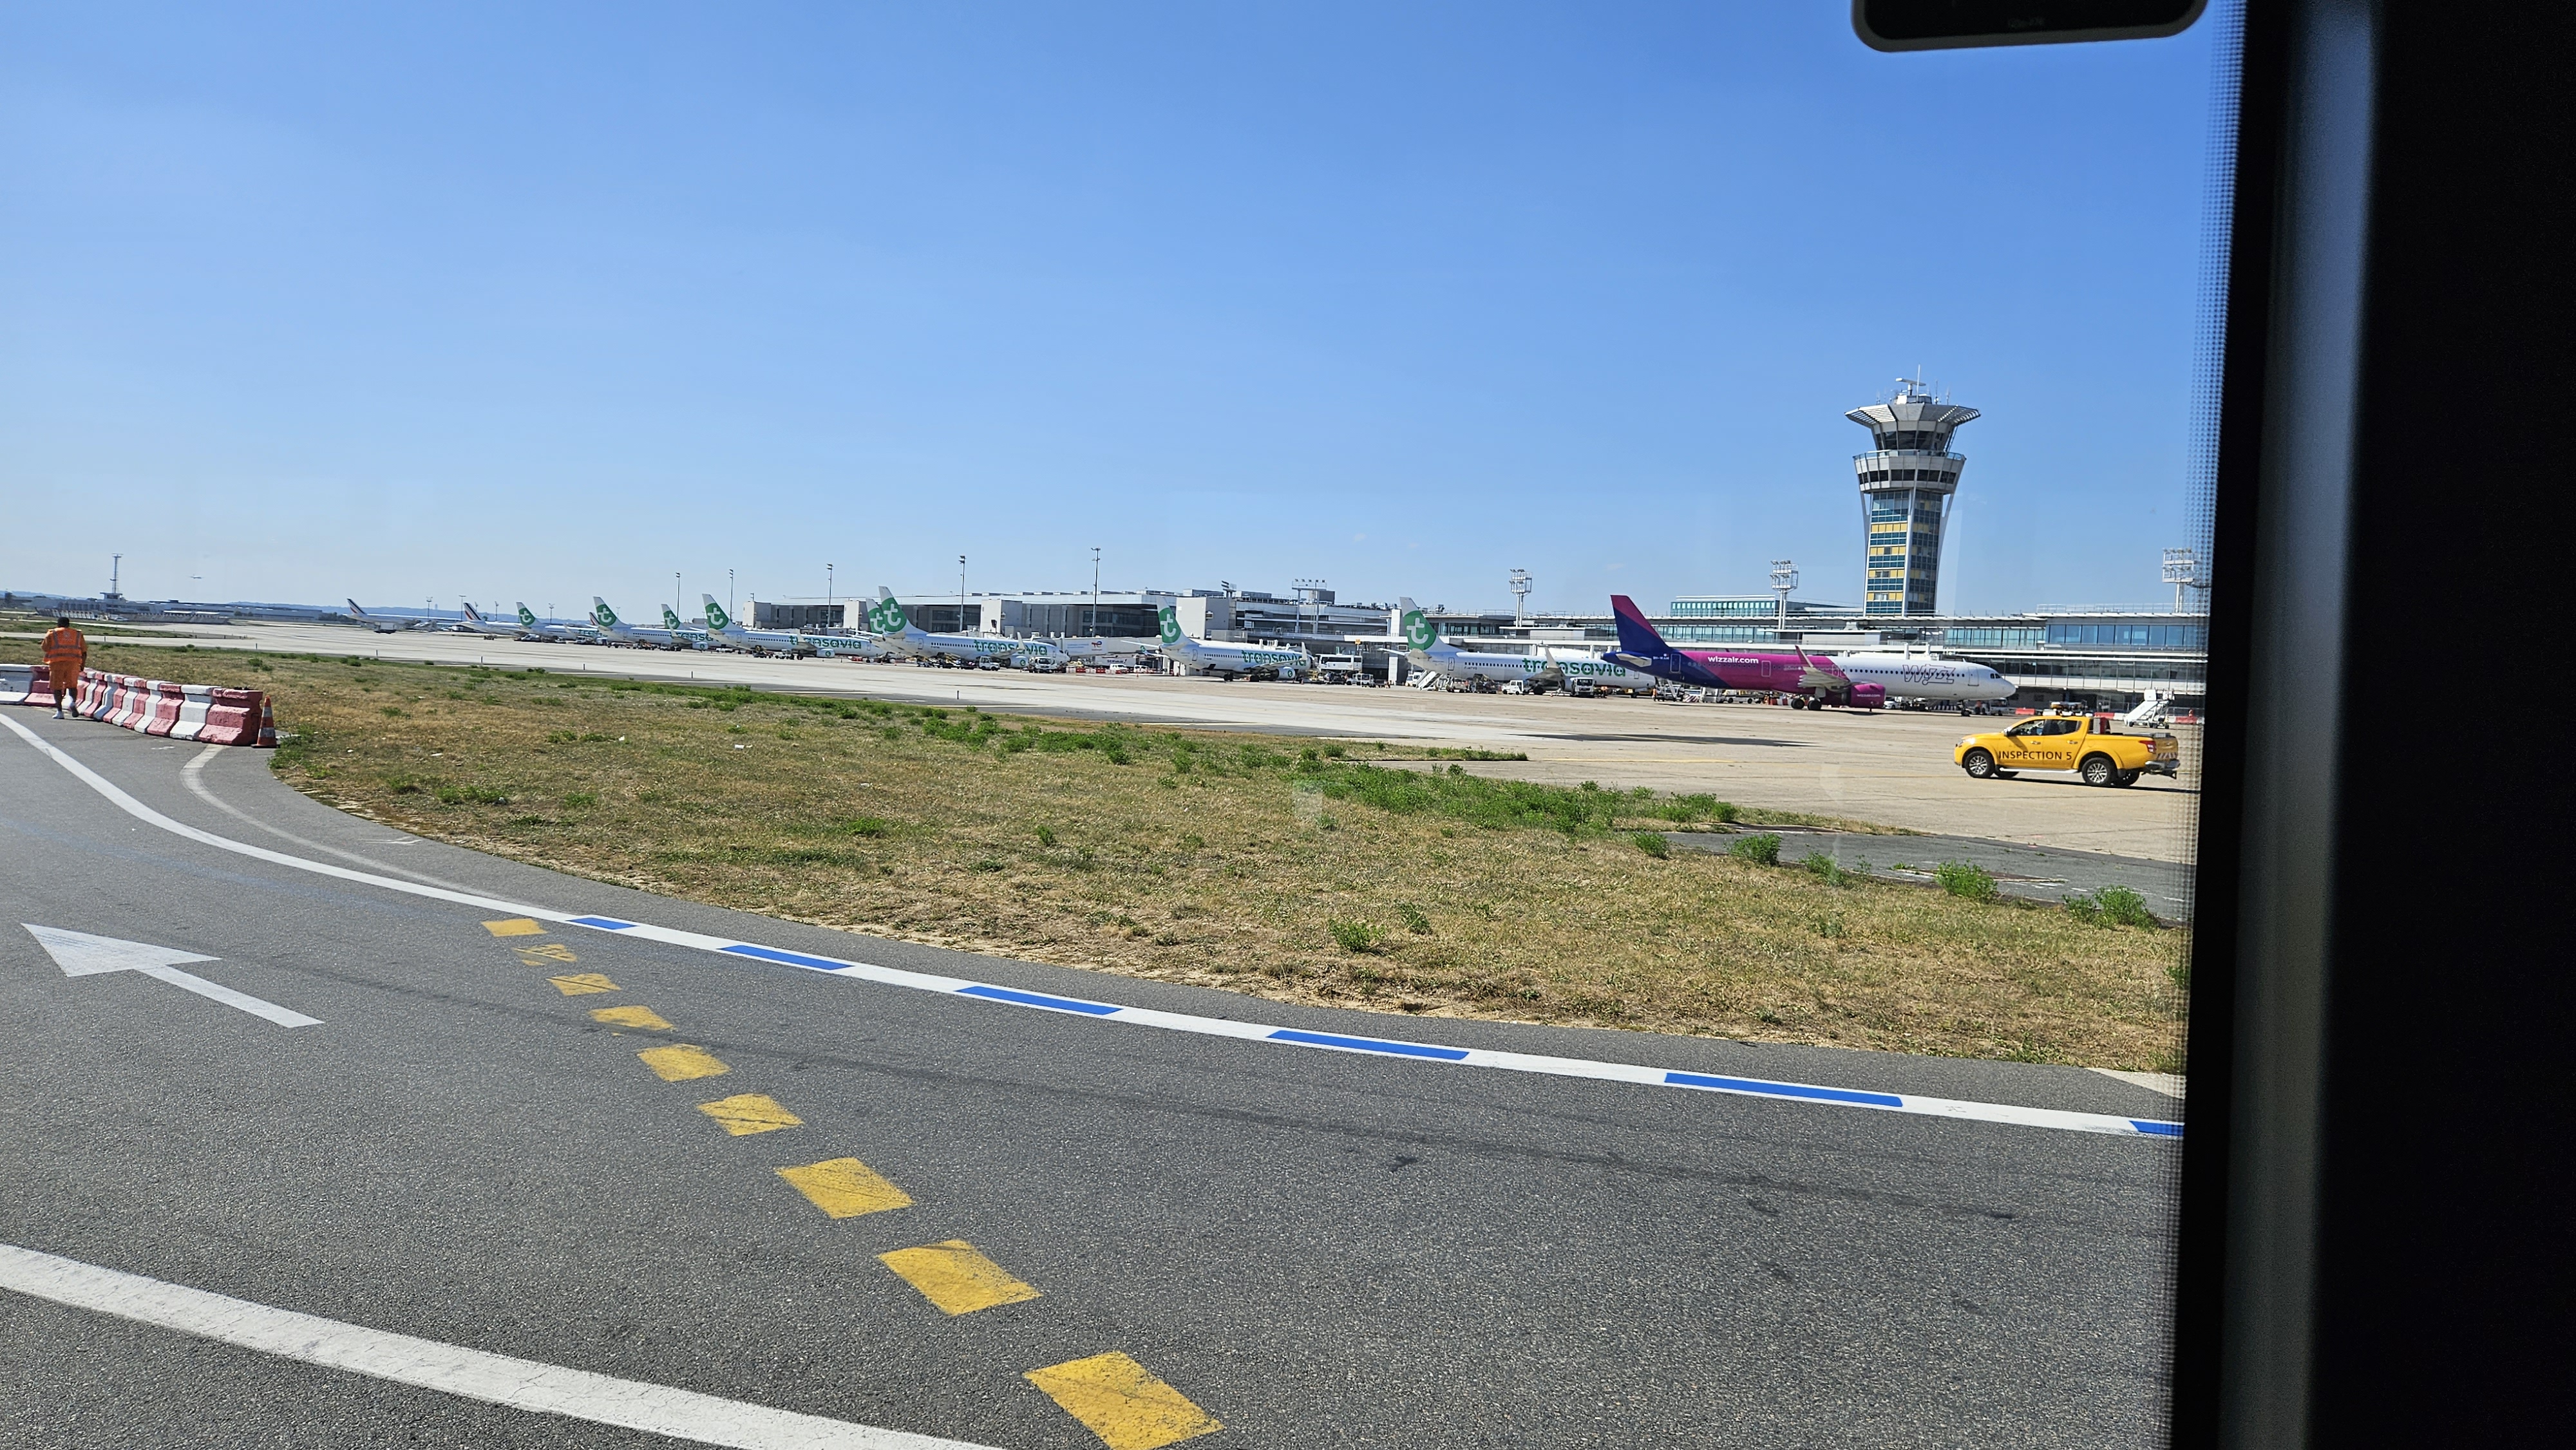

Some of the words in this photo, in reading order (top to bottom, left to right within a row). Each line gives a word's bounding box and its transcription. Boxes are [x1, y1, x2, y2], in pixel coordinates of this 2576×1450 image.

[1707, 655, 1759, 664] wizzair.com
[1998, 751, 2062, 760] INSPECTION
[2066, 751, 2072, 760] 5
